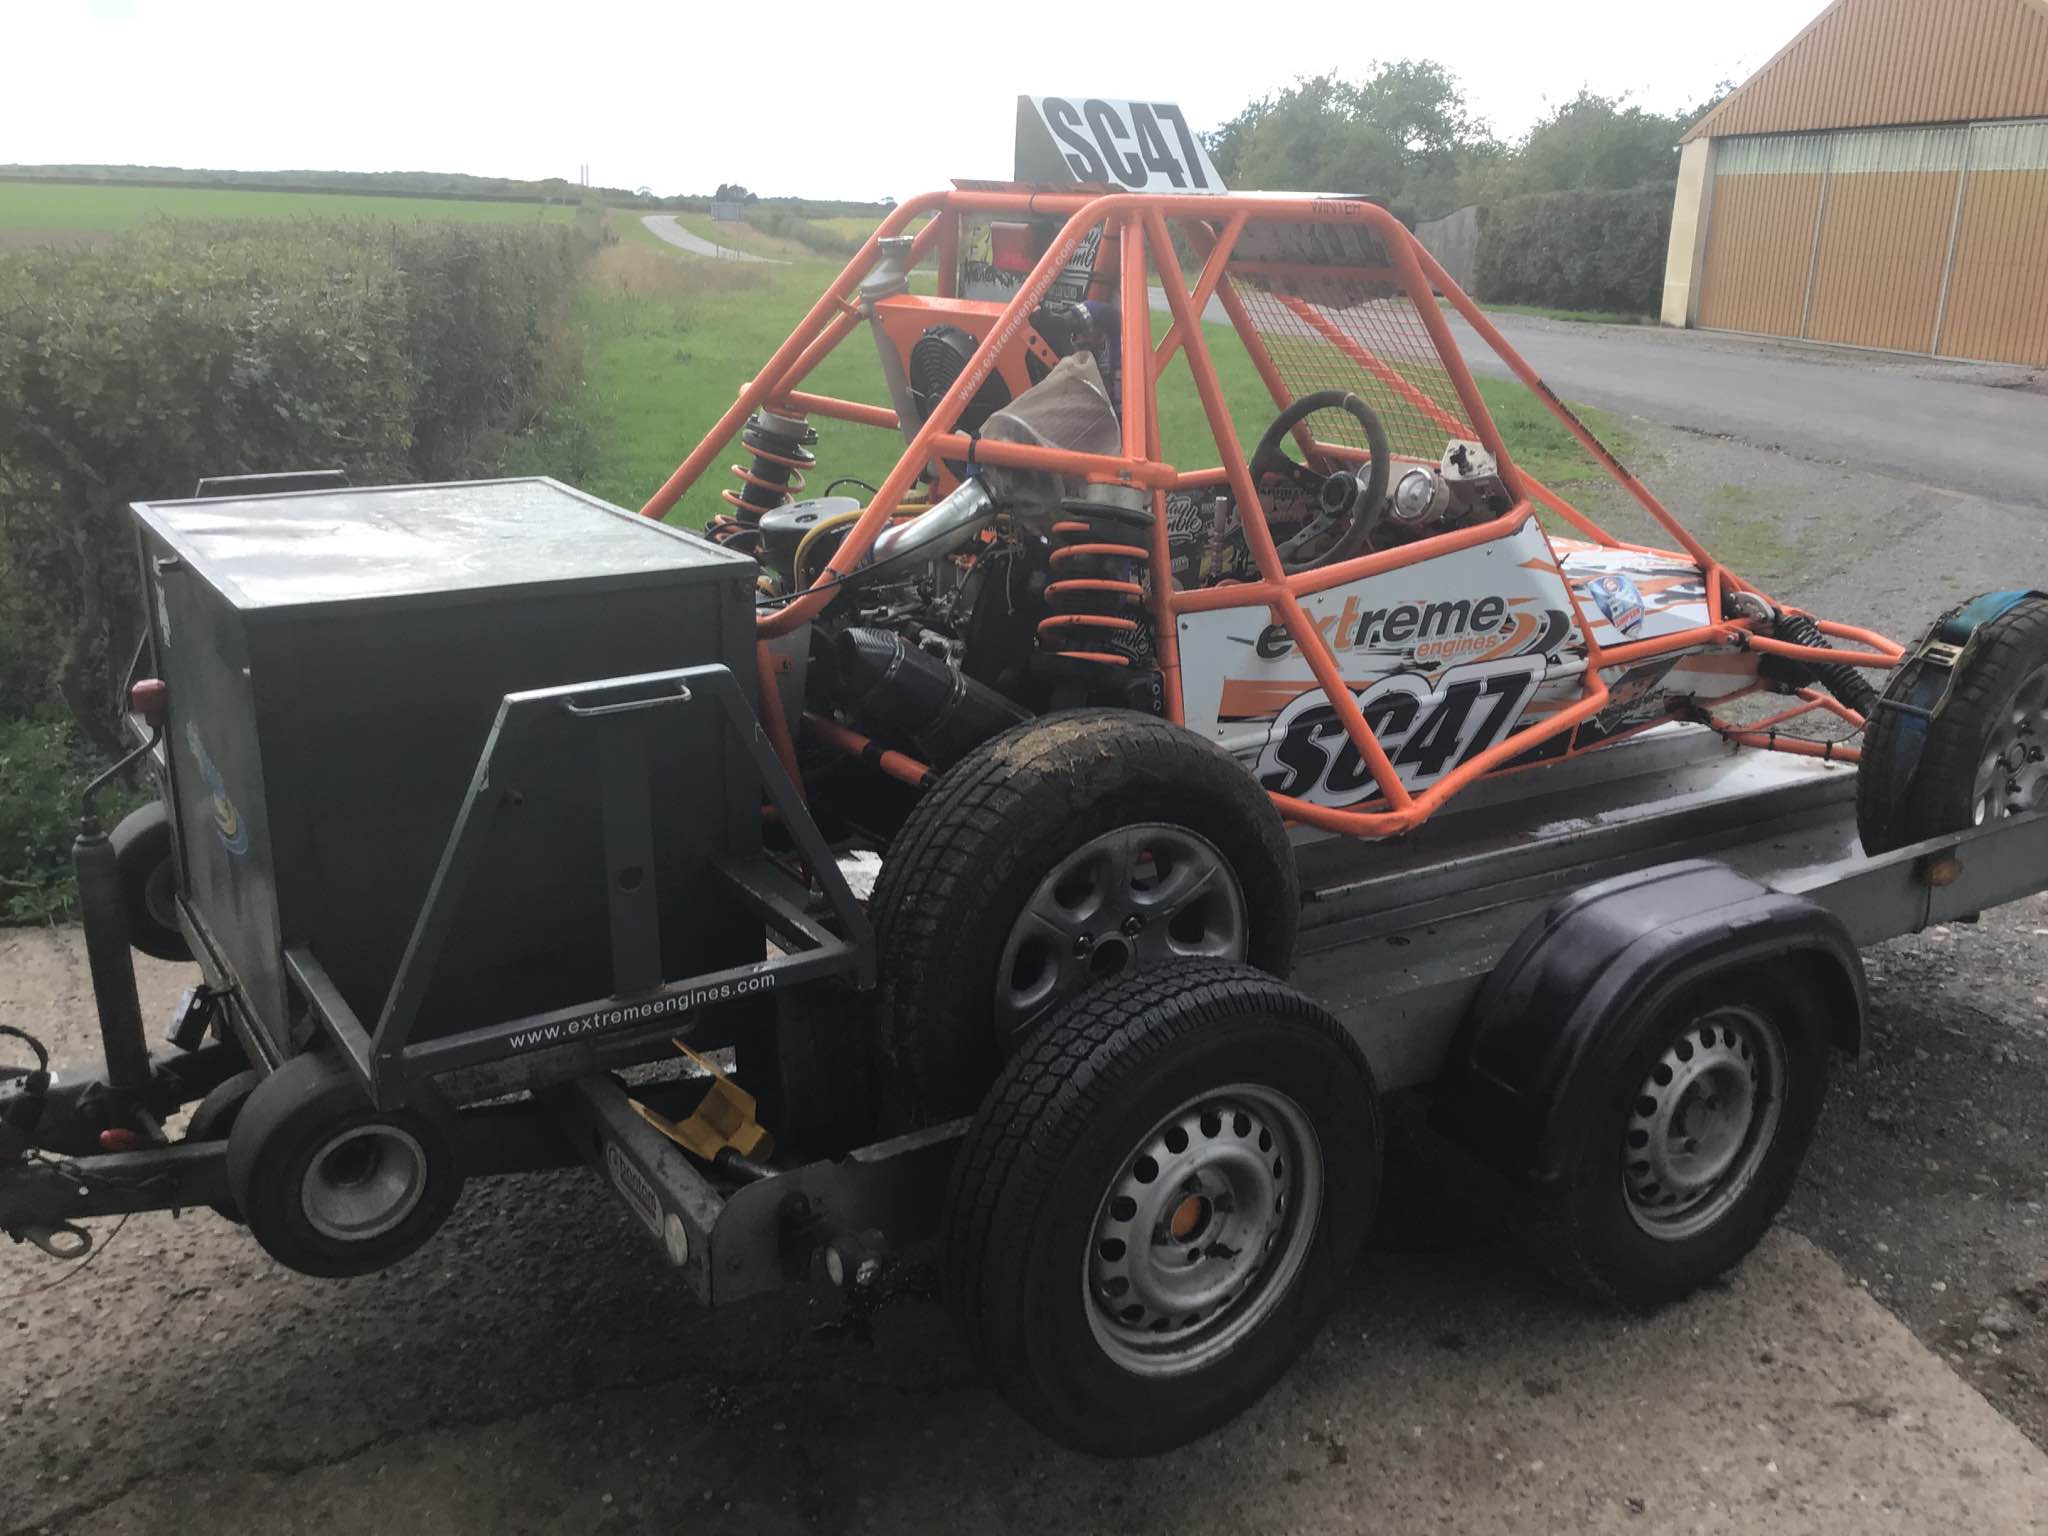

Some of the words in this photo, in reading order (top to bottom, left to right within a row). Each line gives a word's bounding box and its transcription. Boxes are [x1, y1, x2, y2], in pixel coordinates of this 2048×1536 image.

[1042, 97, 1209, 189] SC47
[958, 238, 1077, 401] www.extremeengines.com
[1256, 596, 1505, 670] extreme
[1417, 635, 1498, 660] engines
[1259, 671, 1532, 796] SC47
[509, 972, 776, 1049] www.extremeengines.com
